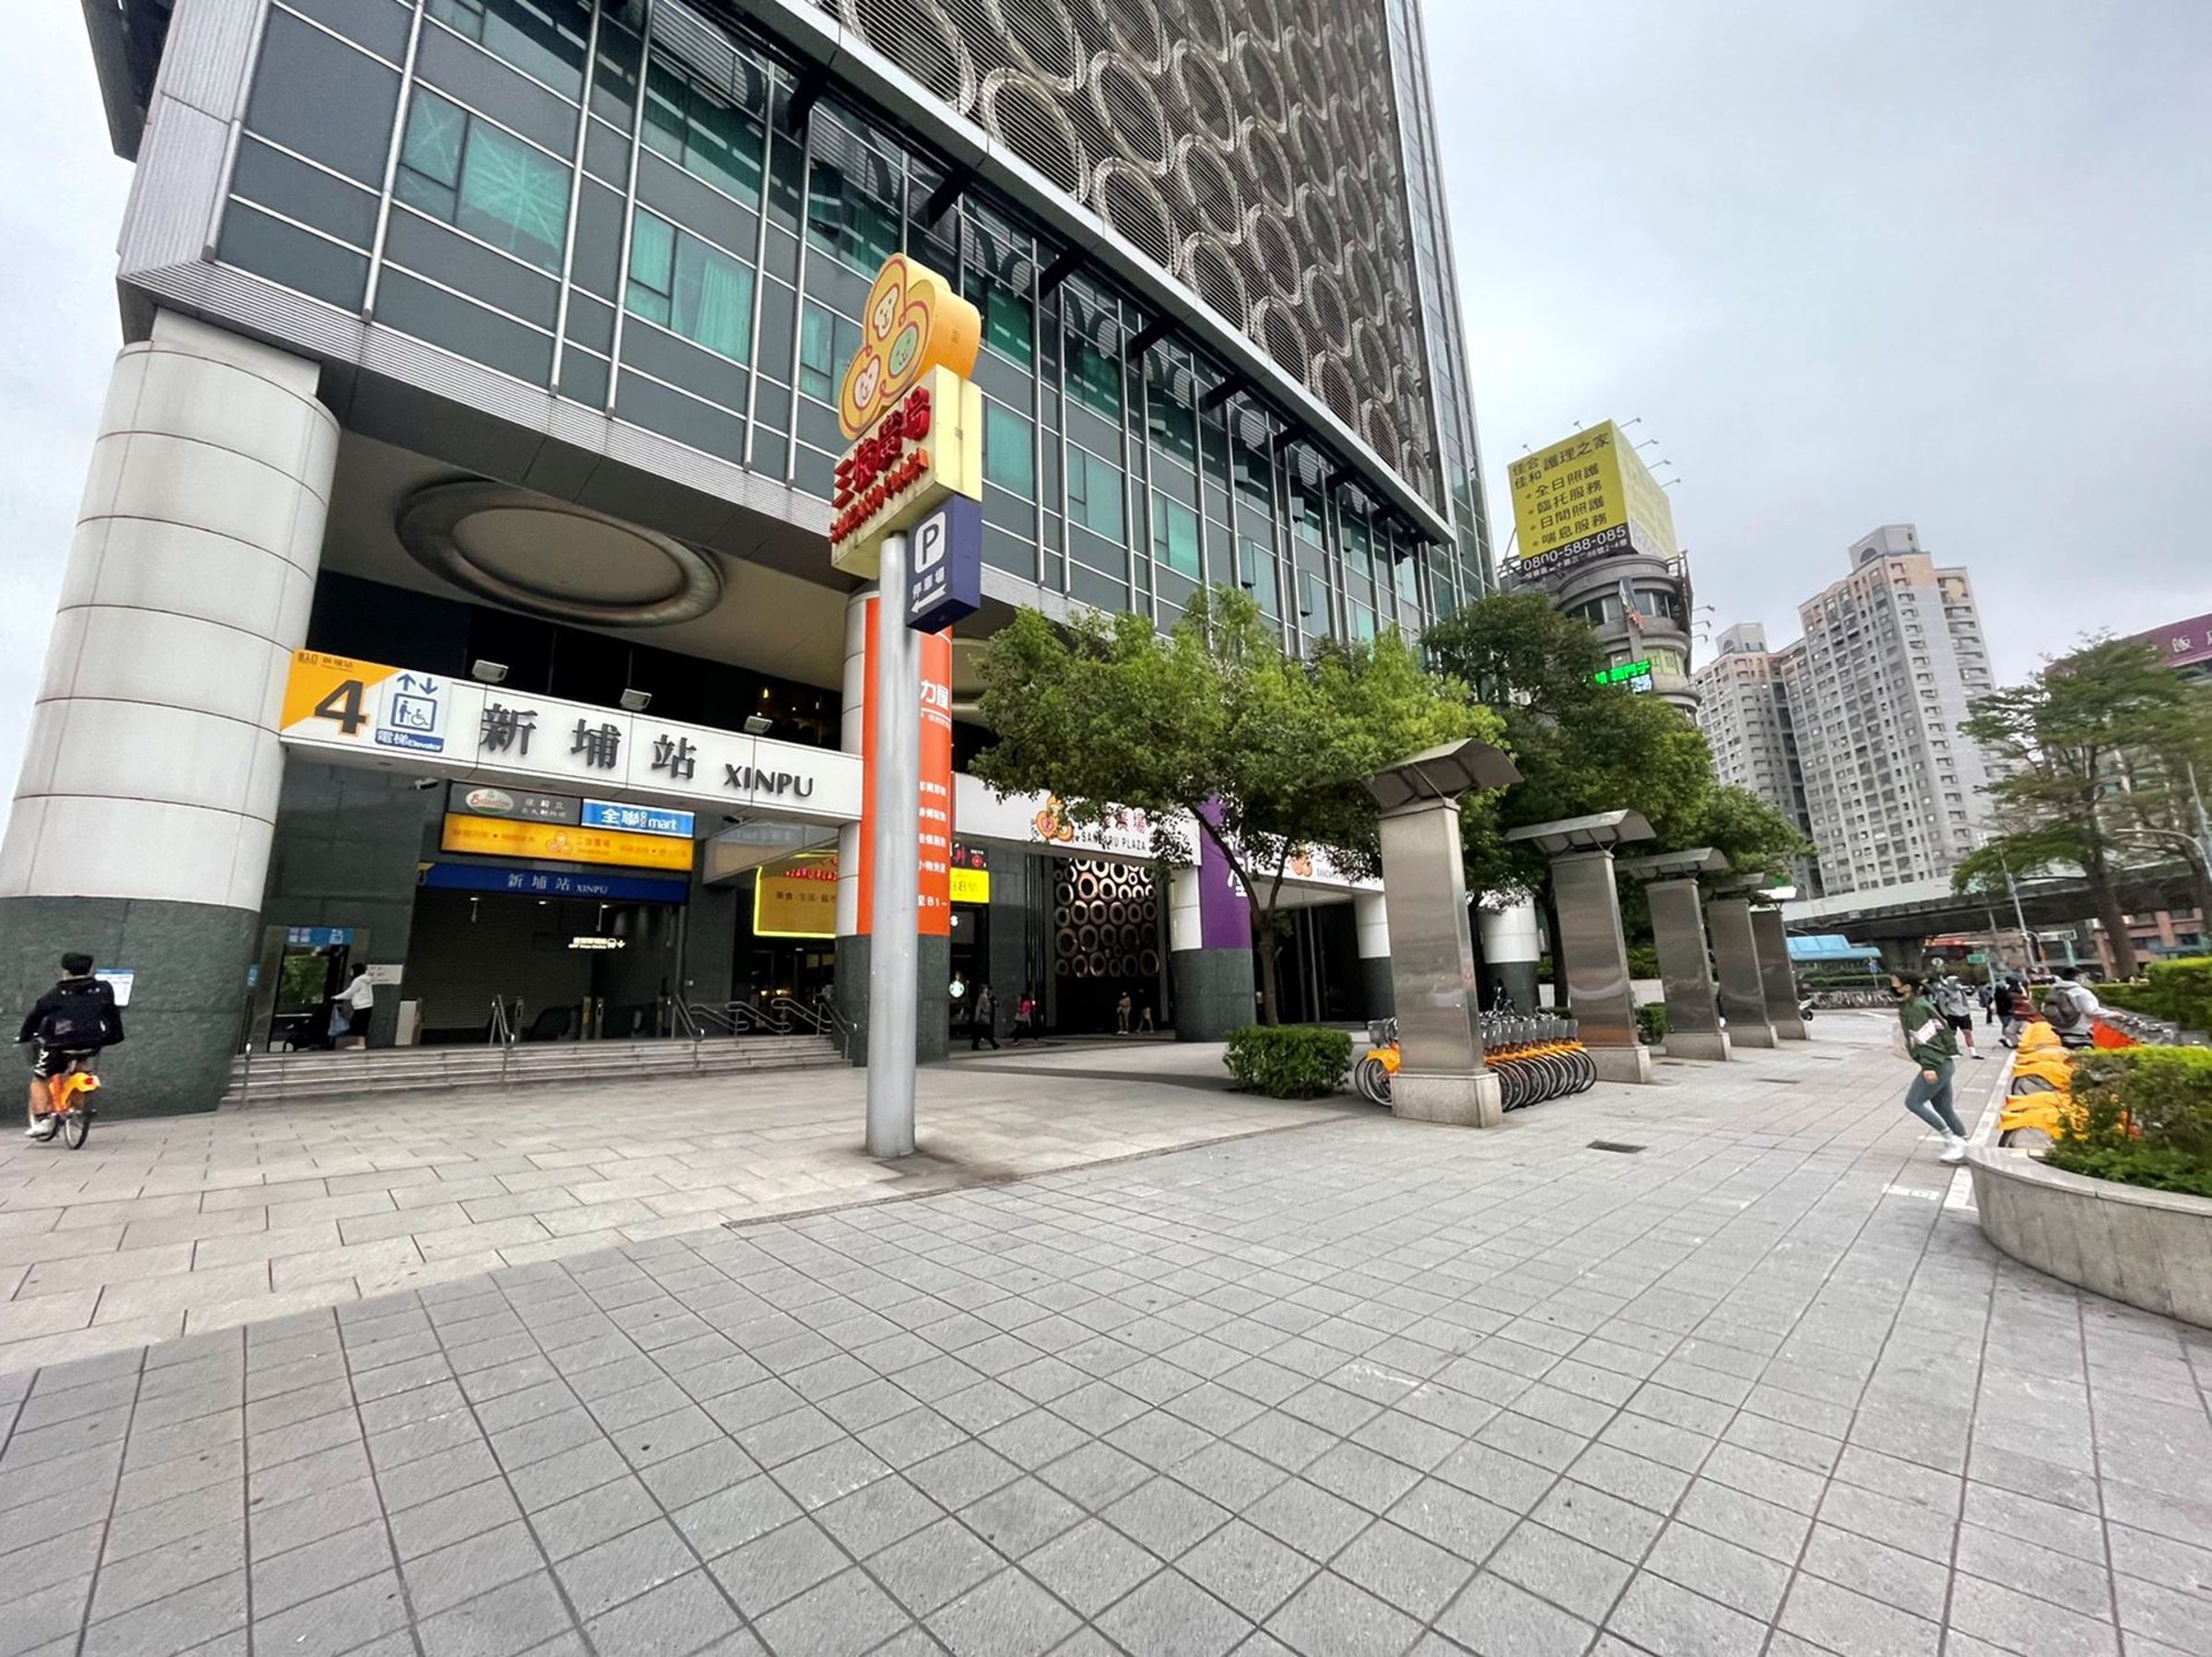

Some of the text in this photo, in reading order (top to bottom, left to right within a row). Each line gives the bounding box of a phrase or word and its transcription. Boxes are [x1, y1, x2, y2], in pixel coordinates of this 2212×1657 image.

[1544, 432, 1609, 472] 護理之家
[1535, 463, 1599, 499] 全日照護
[1540, 495, 1605, 530] 日間照護
[1541, 512, 1607, 545] 喘息服務
[922, 523, 939, 566] P
[1523, 525, 1626, 571] 0800-588-085
[313, 678, 367, 735] 4
[377, 730, 408, 746] 電梯
[479, 702, 815, 798] 新埔站 XINPU
[600, 807, 640, 827] 全聯
[1122, 837, 1147, 851] PLAZA
[508, 872, 609, 895] 新埔站 XINPU
